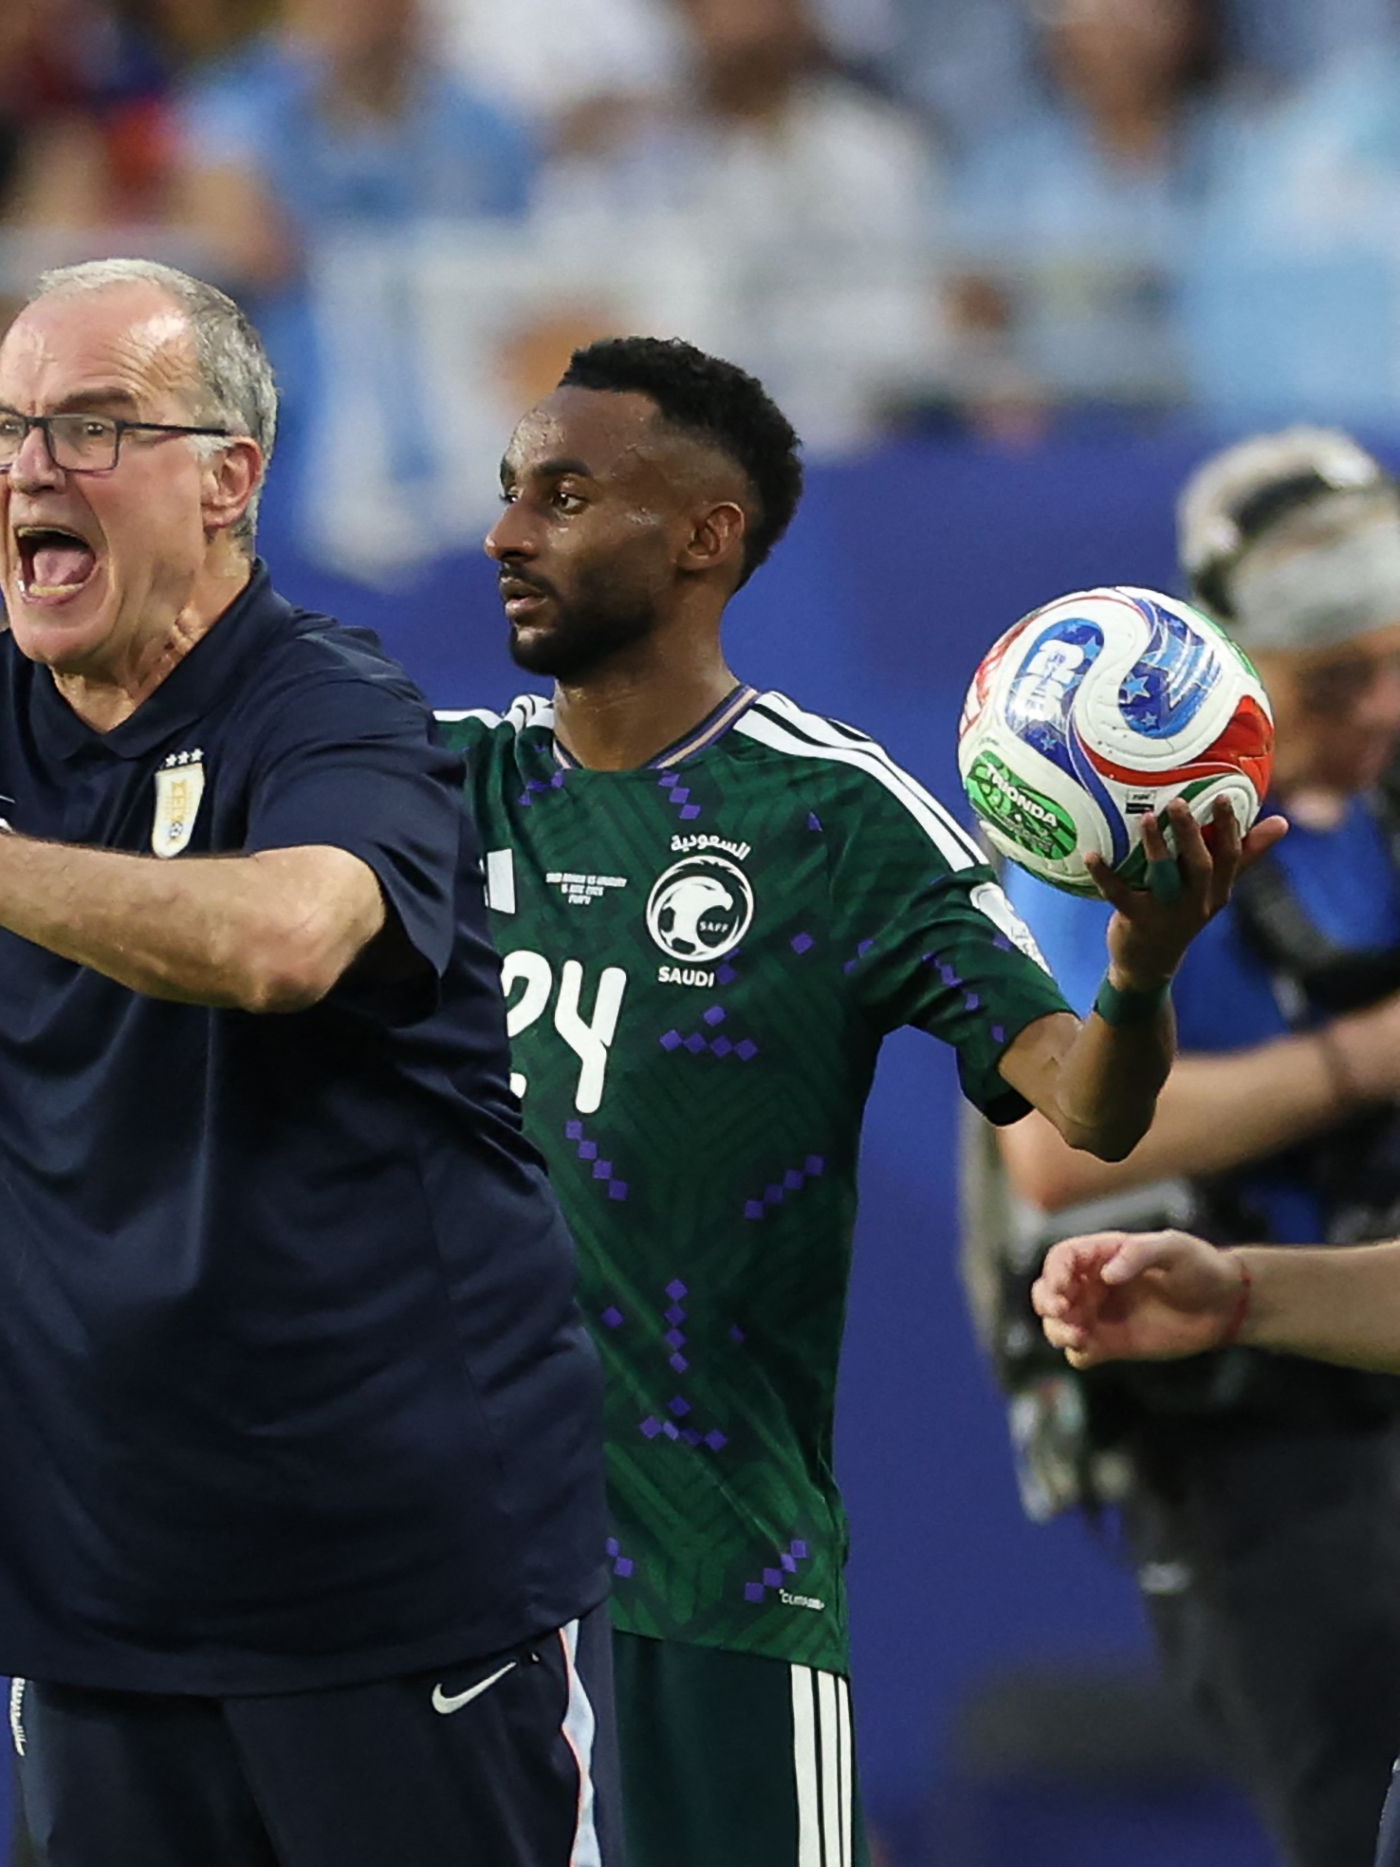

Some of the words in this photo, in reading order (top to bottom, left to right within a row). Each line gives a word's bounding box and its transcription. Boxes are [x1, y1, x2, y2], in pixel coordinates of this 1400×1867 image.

[985, 761, 1058, 828] TRIONDA
[670, 833, 752, 861] السعودية
[699, 920, 729, 933] SAFF
[657, 965, 715, 988] SAUDI
